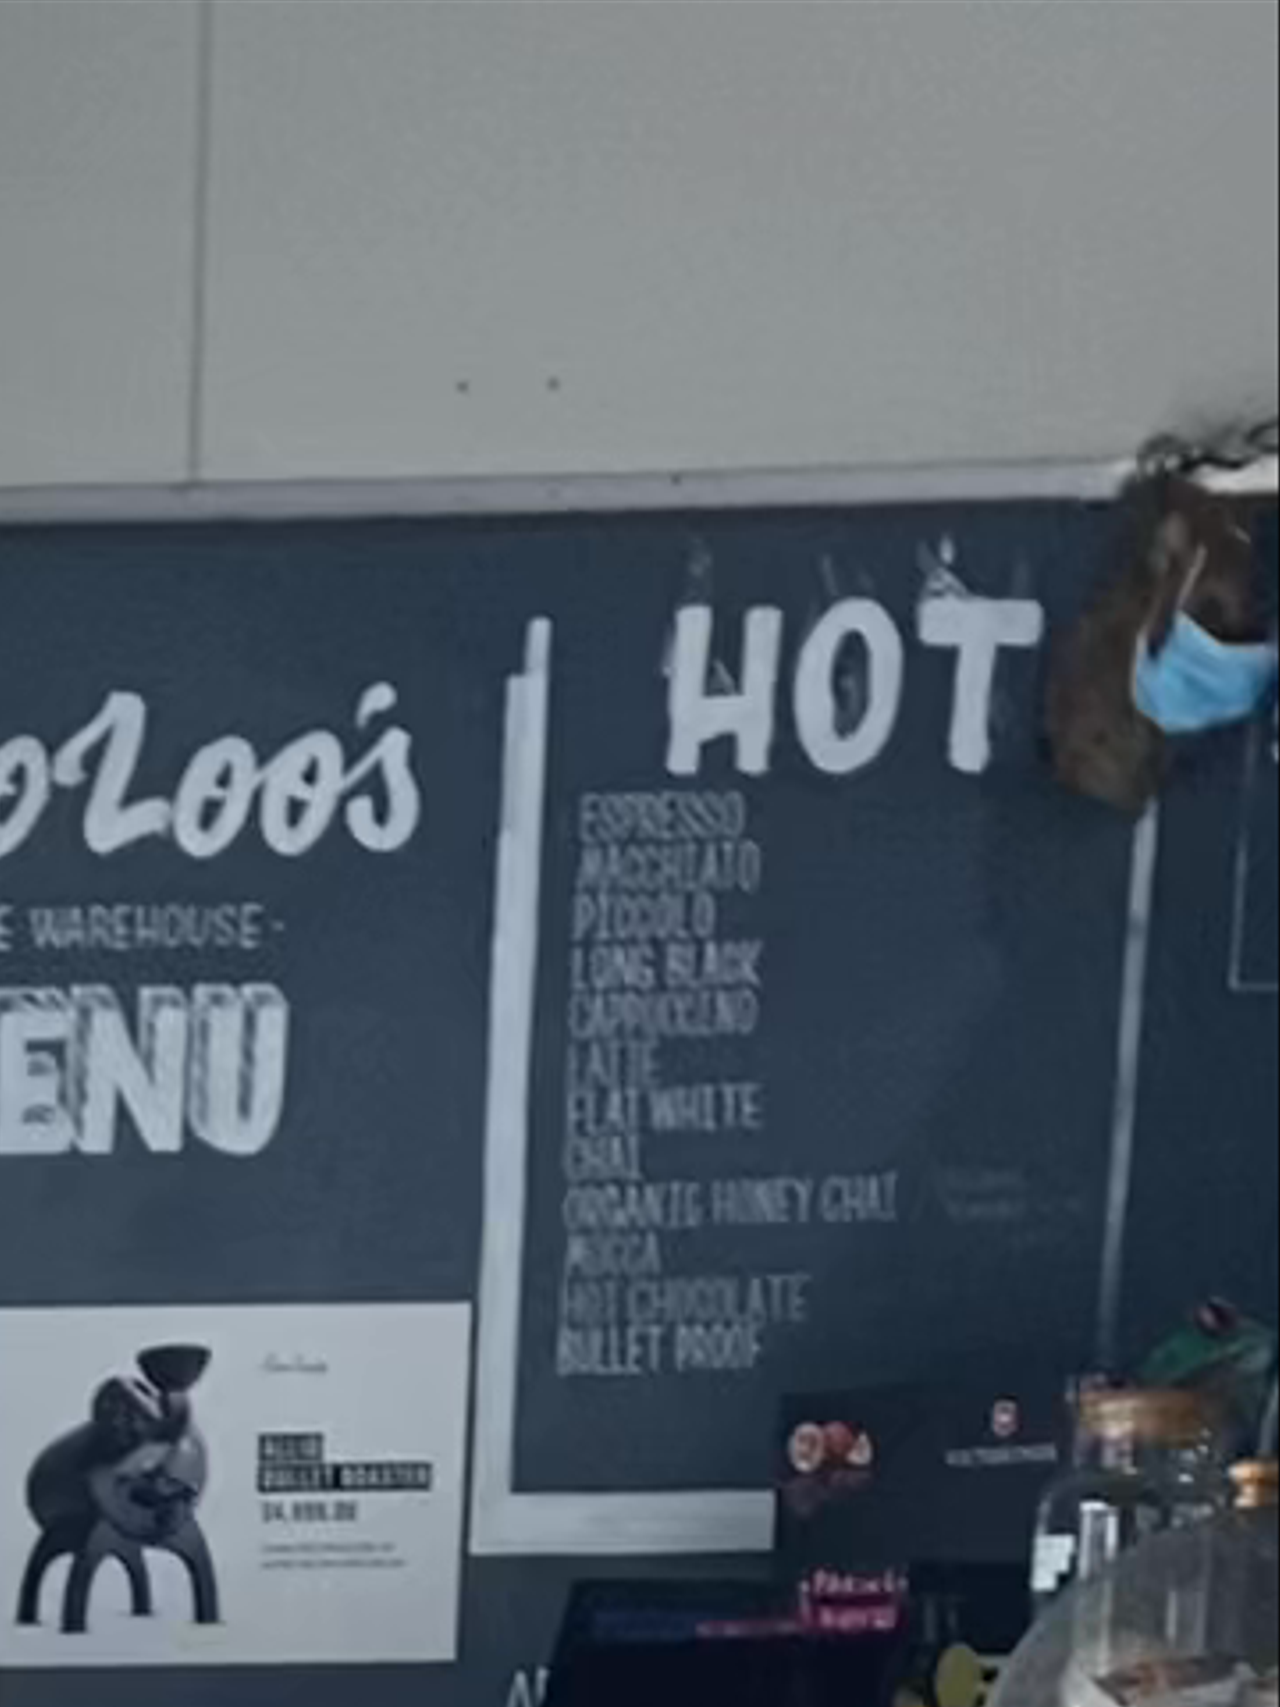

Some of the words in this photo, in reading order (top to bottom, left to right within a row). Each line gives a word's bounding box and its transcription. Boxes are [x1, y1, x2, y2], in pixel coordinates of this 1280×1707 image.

[662, 602, 1042, 778] HOT
[579, 791, 746, 843] ESPRESSO
[576, 840, 761, 893] MACCHIATO
[572, 892, 716, 940] PICCOLO
[570, 944, 655, 991] LONG
[664, 938, 764, 988] BLACK
[566, 1040, 659, 1090] LATTE
[566, 1088, 638, 1133] FLAT
[650, 1083, 764, 1131] WHITE
[563, 1136, 642, 1180] CHAI
[561, 1182, 701, 1230] ORGANIC
[712, 1177, 814, 1222] HONEY
[817, 1171, 899, 1221] CHAI
[565, 1277, 620, 1326] HOT
[626, 1274, 813, 1325] CHOCOLATE
[556, 1323, 664, 1376] BULLET
[675, 1323, 765, 1371] PROOF
